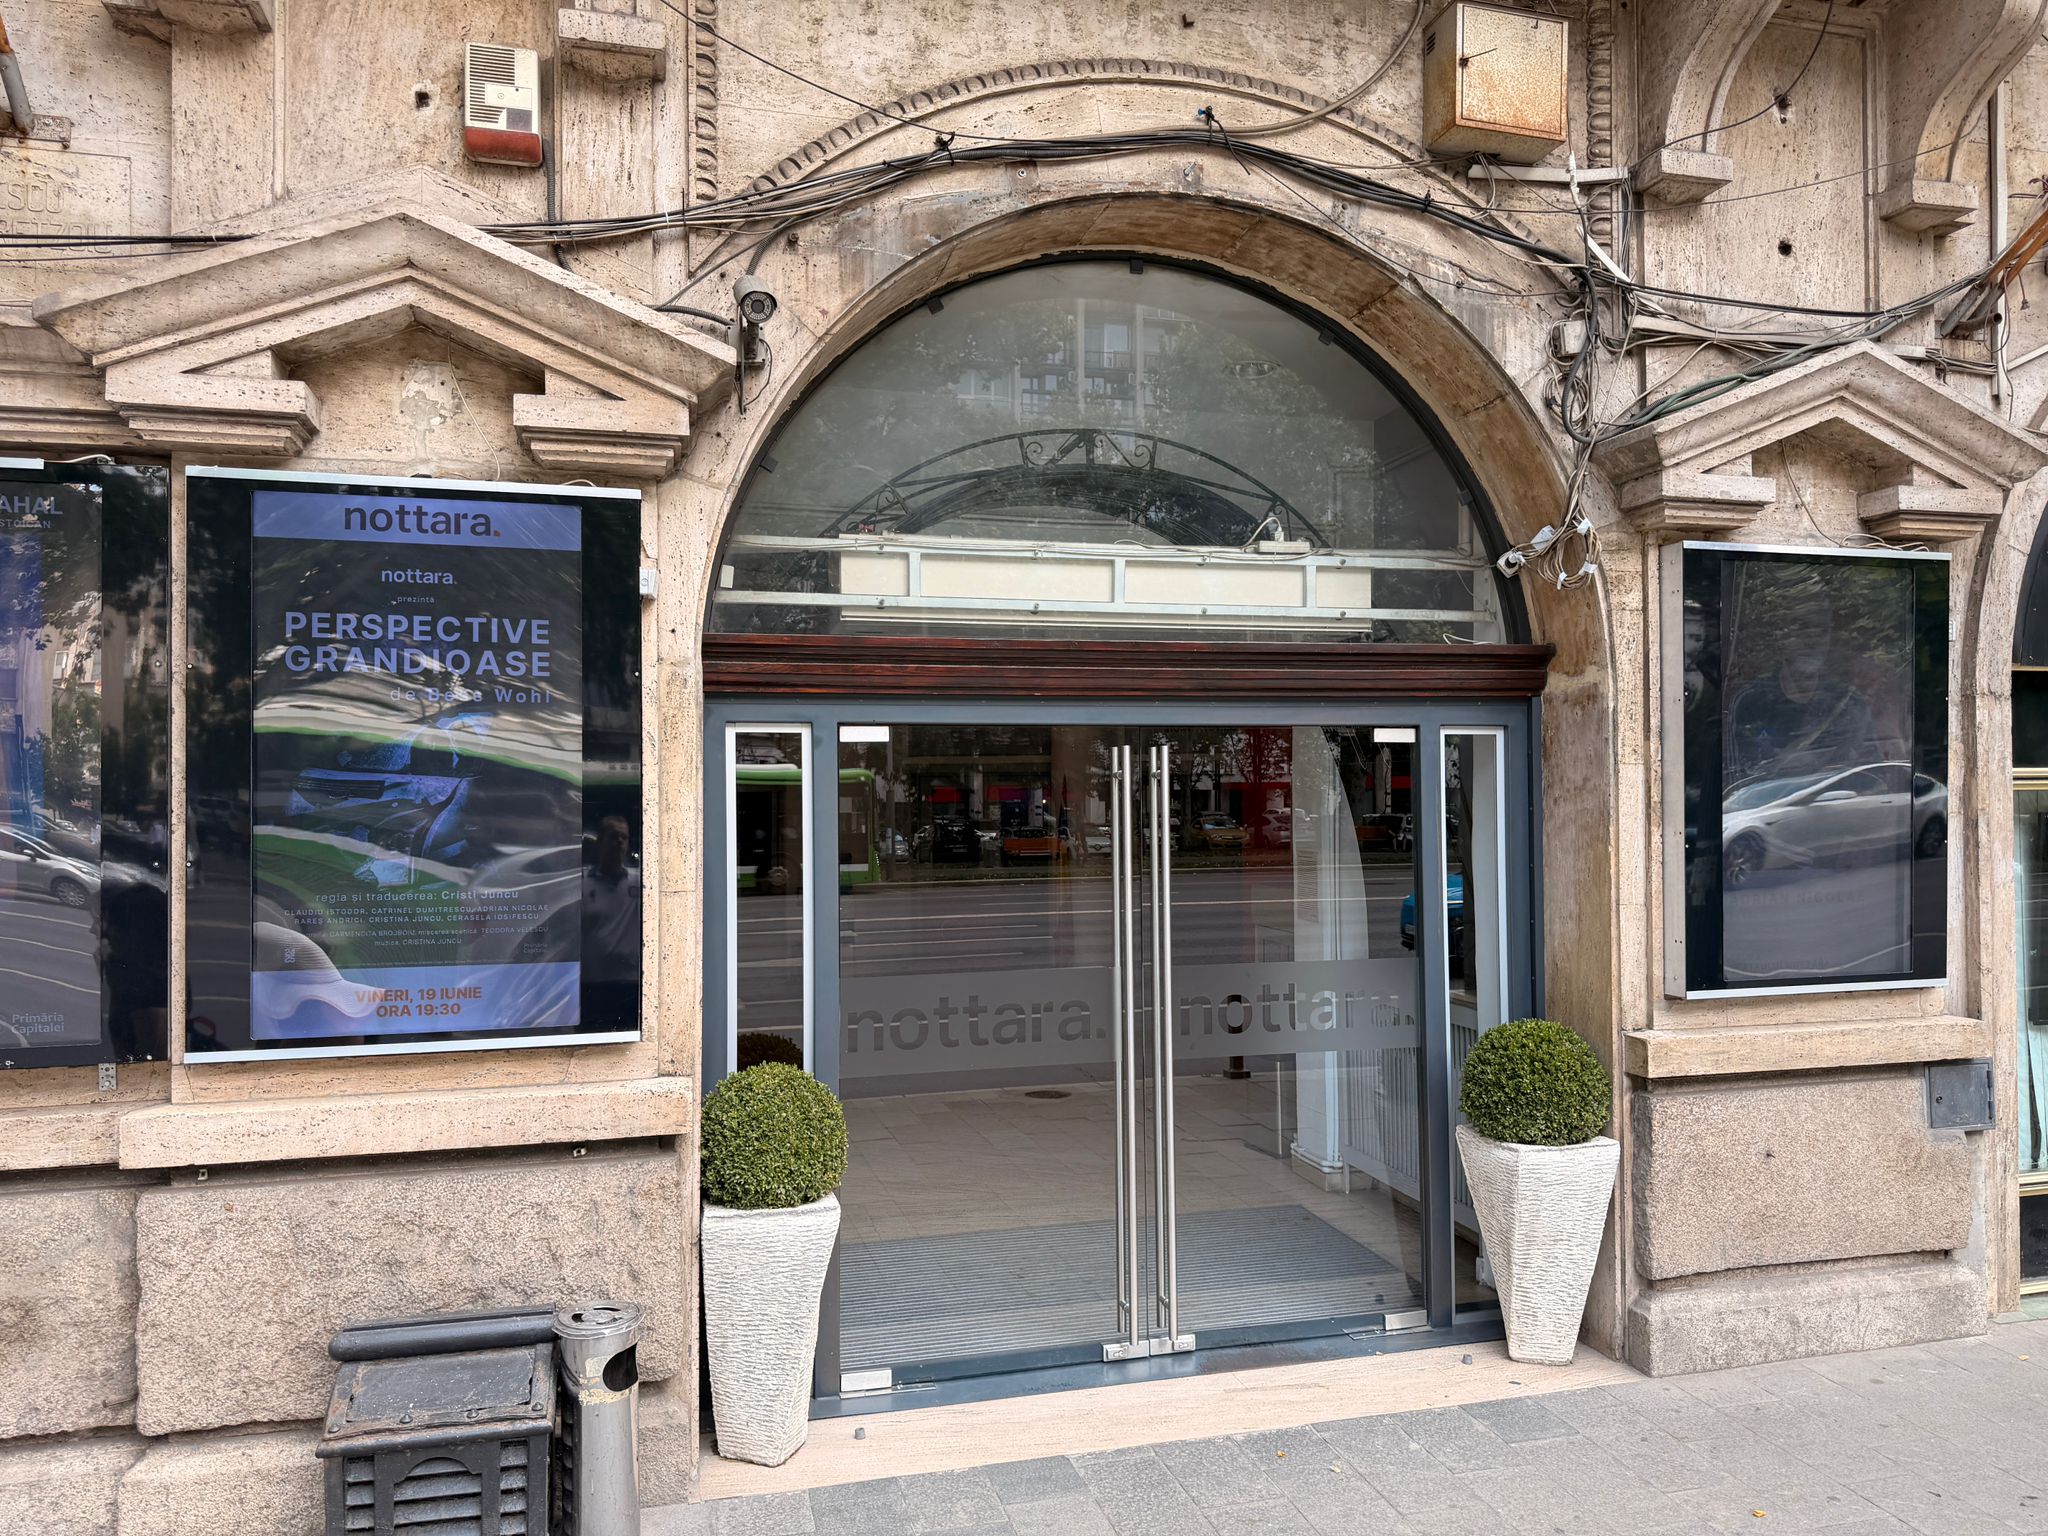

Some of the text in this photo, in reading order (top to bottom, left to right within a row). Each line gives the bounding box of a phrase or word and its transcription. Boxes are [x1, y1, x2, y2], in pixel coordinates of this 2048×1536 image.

[343, 504, 501, 538] nottara.
[285, 611, 550, 645] PERSPECTIVE
[285, 645, 551, 677] GRANDIOASE
[390, 688, 416, 702] de
[495, 688, 550, 704] Wohl
[316, 893, 347, 904] regia
[366, 891, 438, 901] traducerea:
[441, 890, 477, 900] Cristi
[480, 890, 519, 900] Juncu
[354, 986, 483, 1004] VINERI, 19 IUNIE
[375, 1002, 462, 1018] ORA 19:30
[847, 995, 1107, 1053] nottara.
